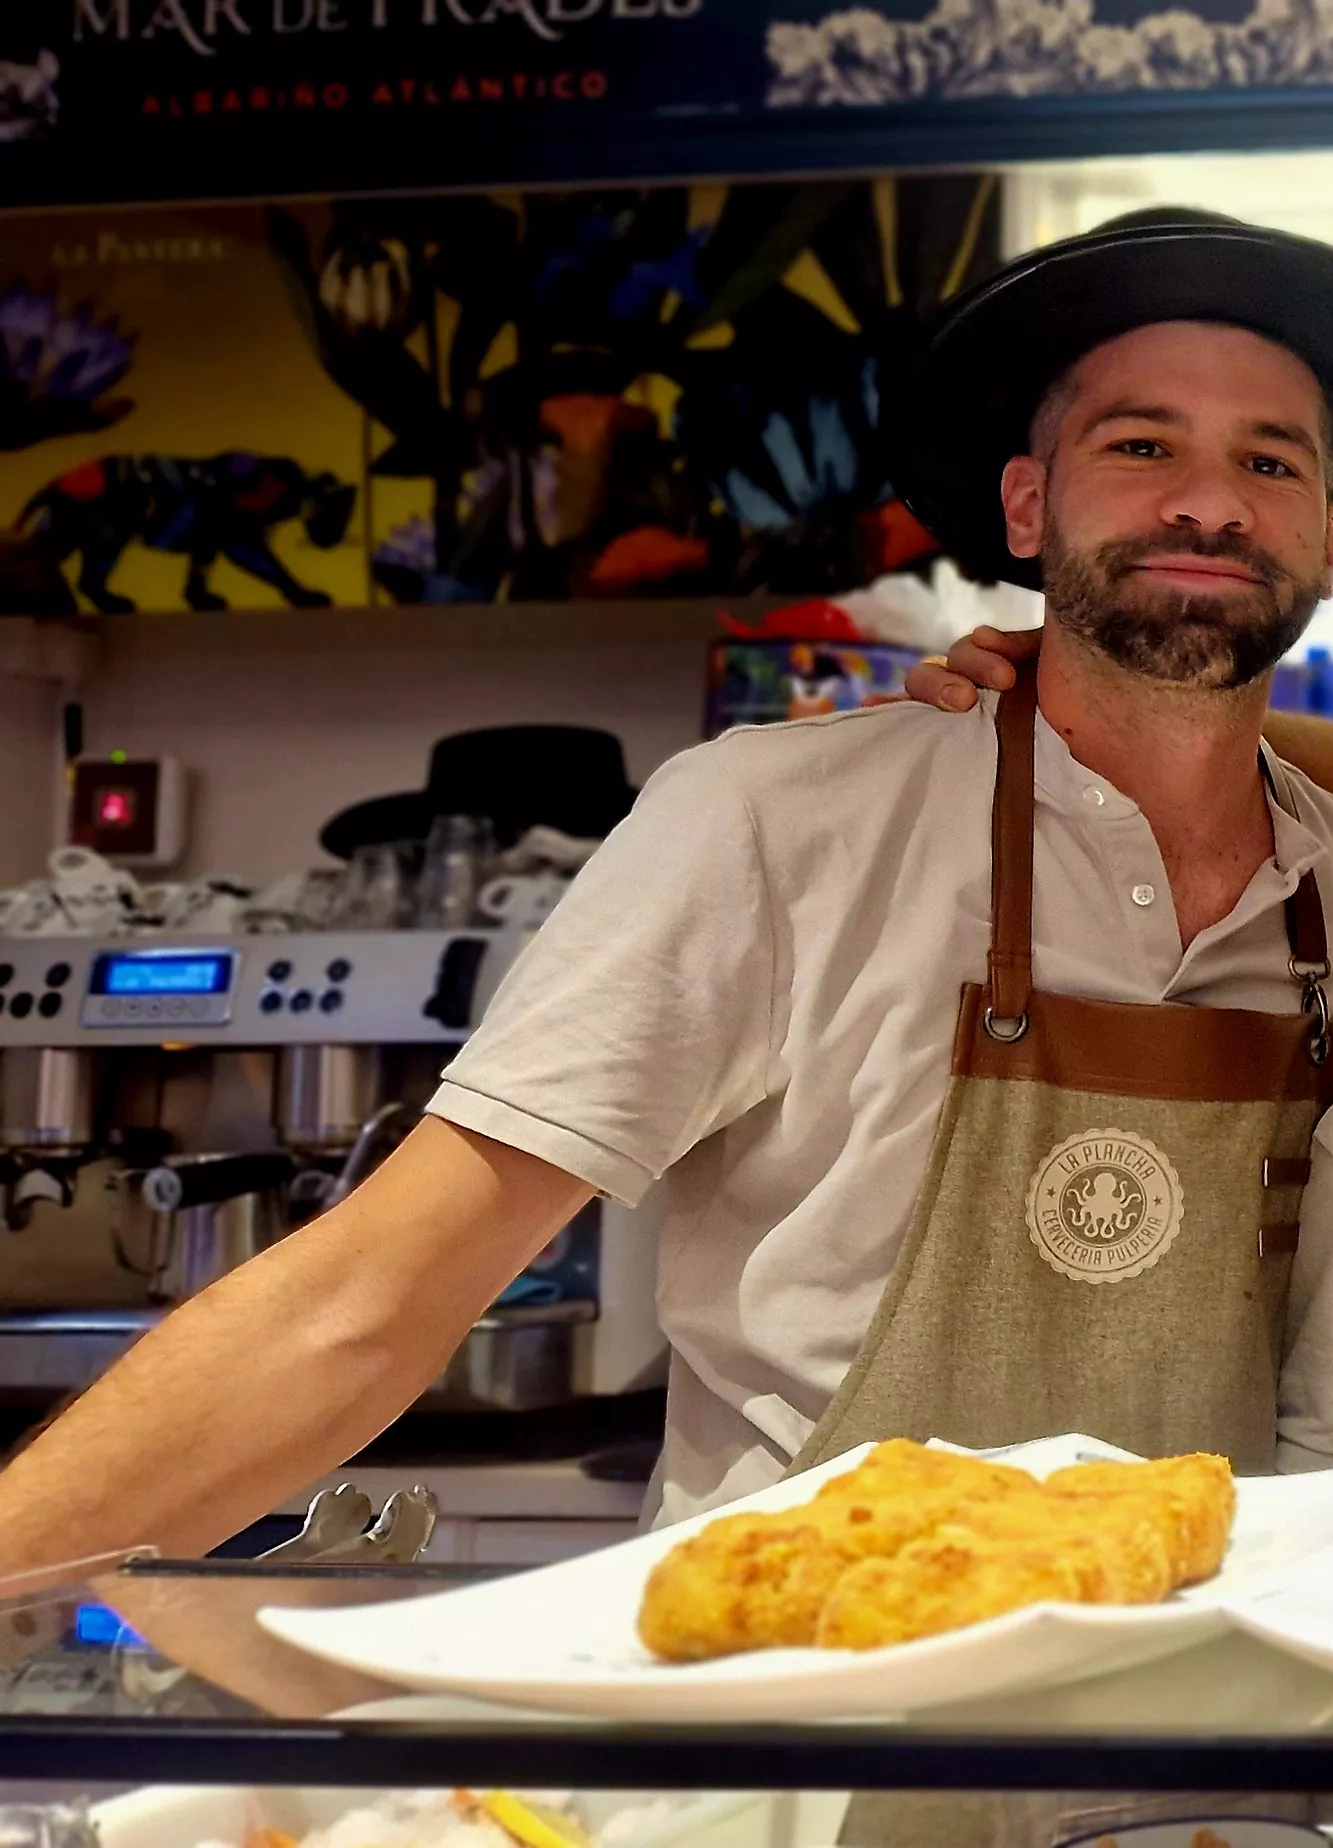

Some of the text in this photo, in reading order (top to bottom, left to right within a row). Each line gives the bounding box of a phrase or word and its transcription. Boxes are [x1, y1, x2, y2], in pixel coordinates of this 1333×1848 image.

[1058, 1143, 1156, 1181] LA PLANCHA
[1041, 1208, 1164, 1265] CERVECERIA PULPERIA
